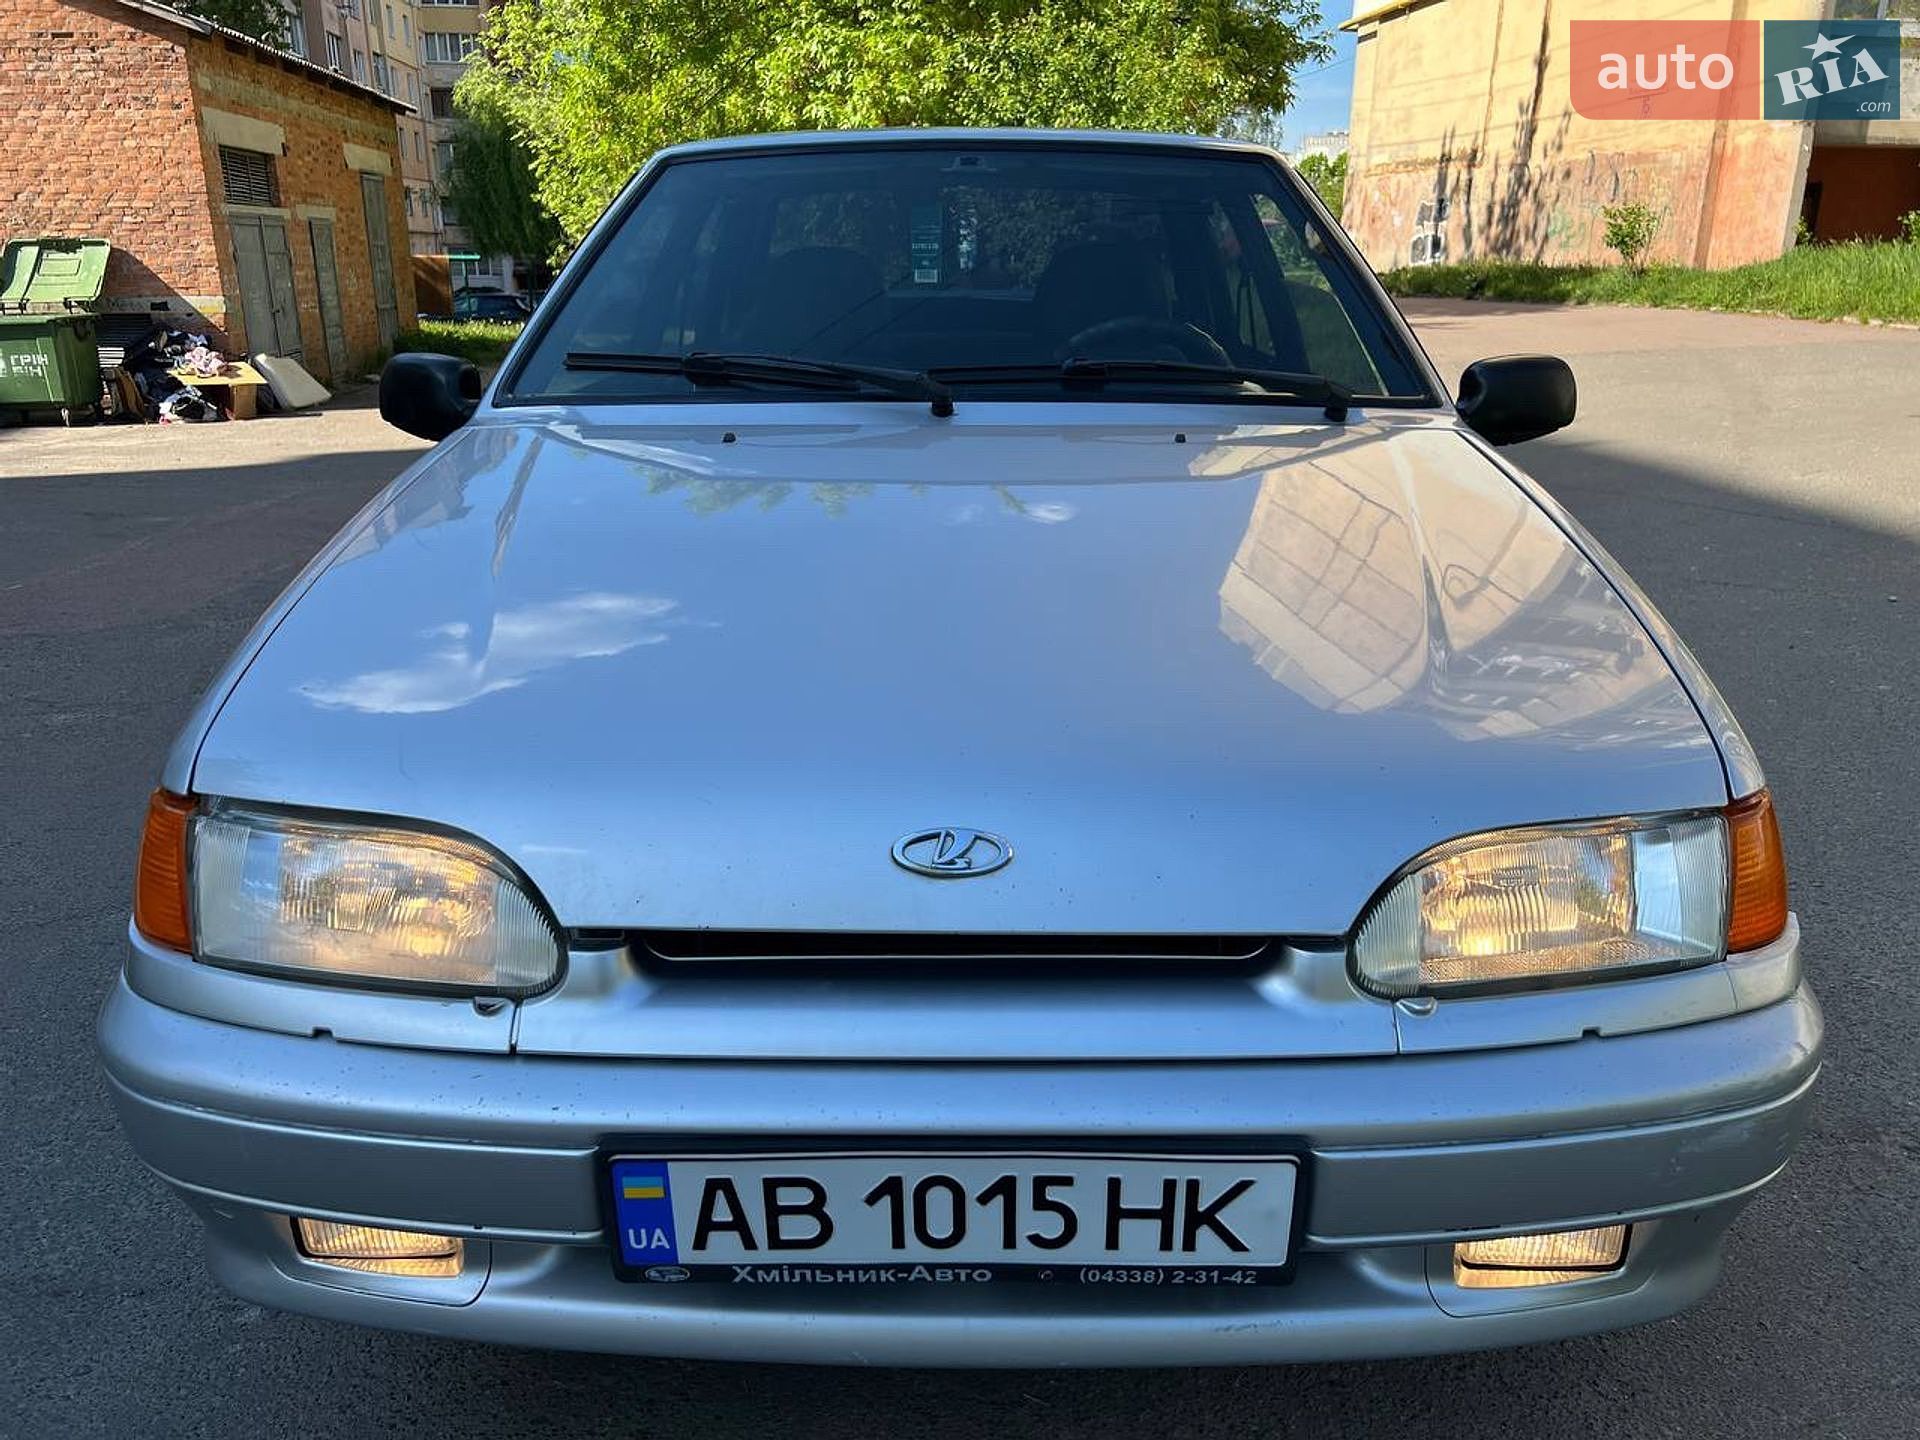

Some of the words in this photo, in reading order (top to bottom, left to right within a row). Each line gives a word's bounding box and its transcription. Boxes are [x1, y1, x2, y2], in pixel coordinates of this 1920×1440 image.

[692, 1176, 834, 1251] AB
[863, 1174, 1078, 1250] 1015
[1105, 1176, 1257, 1252] HK
[628, 1228, 670, 1249] UA
[1079, 1268, 1164, 1285] (04338)
[1171, 1269, 1258, 1285] 2-31-42
